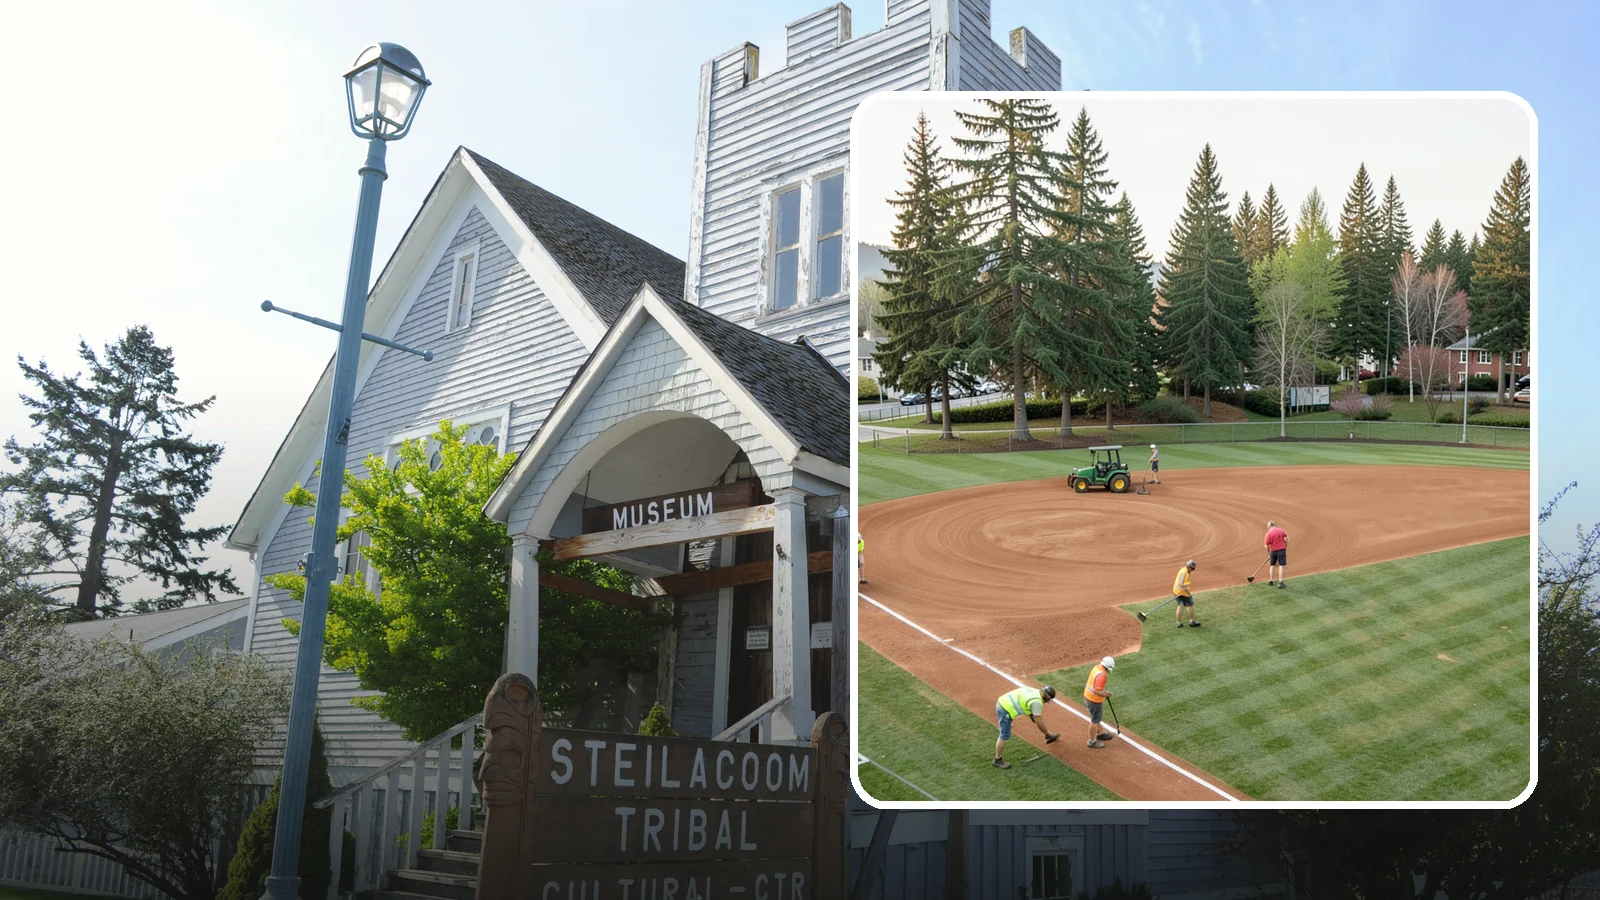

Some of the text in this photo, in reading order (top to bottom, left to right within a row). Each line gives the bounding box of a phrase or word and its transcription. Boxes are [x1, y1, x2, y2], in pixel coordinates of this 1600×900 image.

[612, 491, 714, 530] MUSEUM
[550, 738, 809, 793] STEILACOOM
[614, 806, 758, 852] TRIBAL
